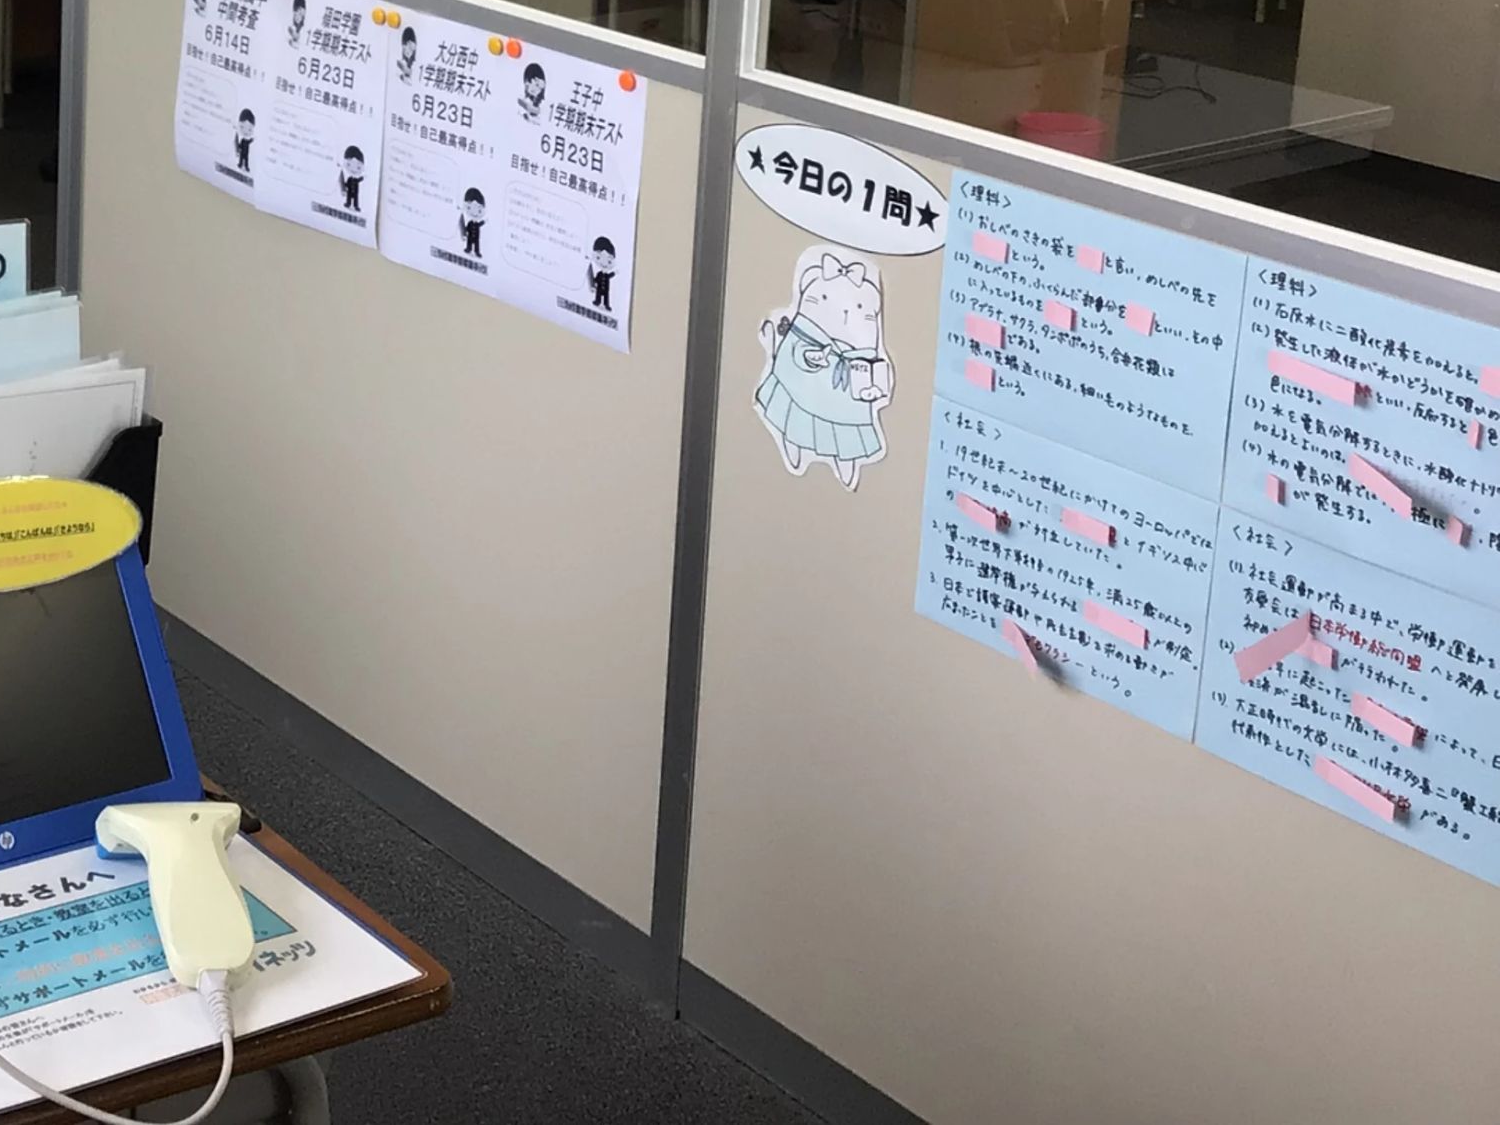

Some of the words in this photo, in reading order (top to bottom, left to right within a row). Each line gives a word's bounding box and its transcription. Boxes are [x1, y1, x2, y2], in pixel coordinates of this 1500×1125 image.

[216, 0, 261, 32] 中間考査
[204, 23, 251, 56] 6月14日
[305, 28, 373, 65] 1学期期末テスト
[434, 40, 480, 73] 大分西中
[297, 56, 356, 91] 6月23日
[418, 64, 492, 103] 1学期期末テスト
[411, 92, 474, 129] 6月23日
[569, 79, 605, 110] 王子中
[548, 101, 625, 147] 1学期期末テスト
[540, 132, 605, 174] 6月23日
